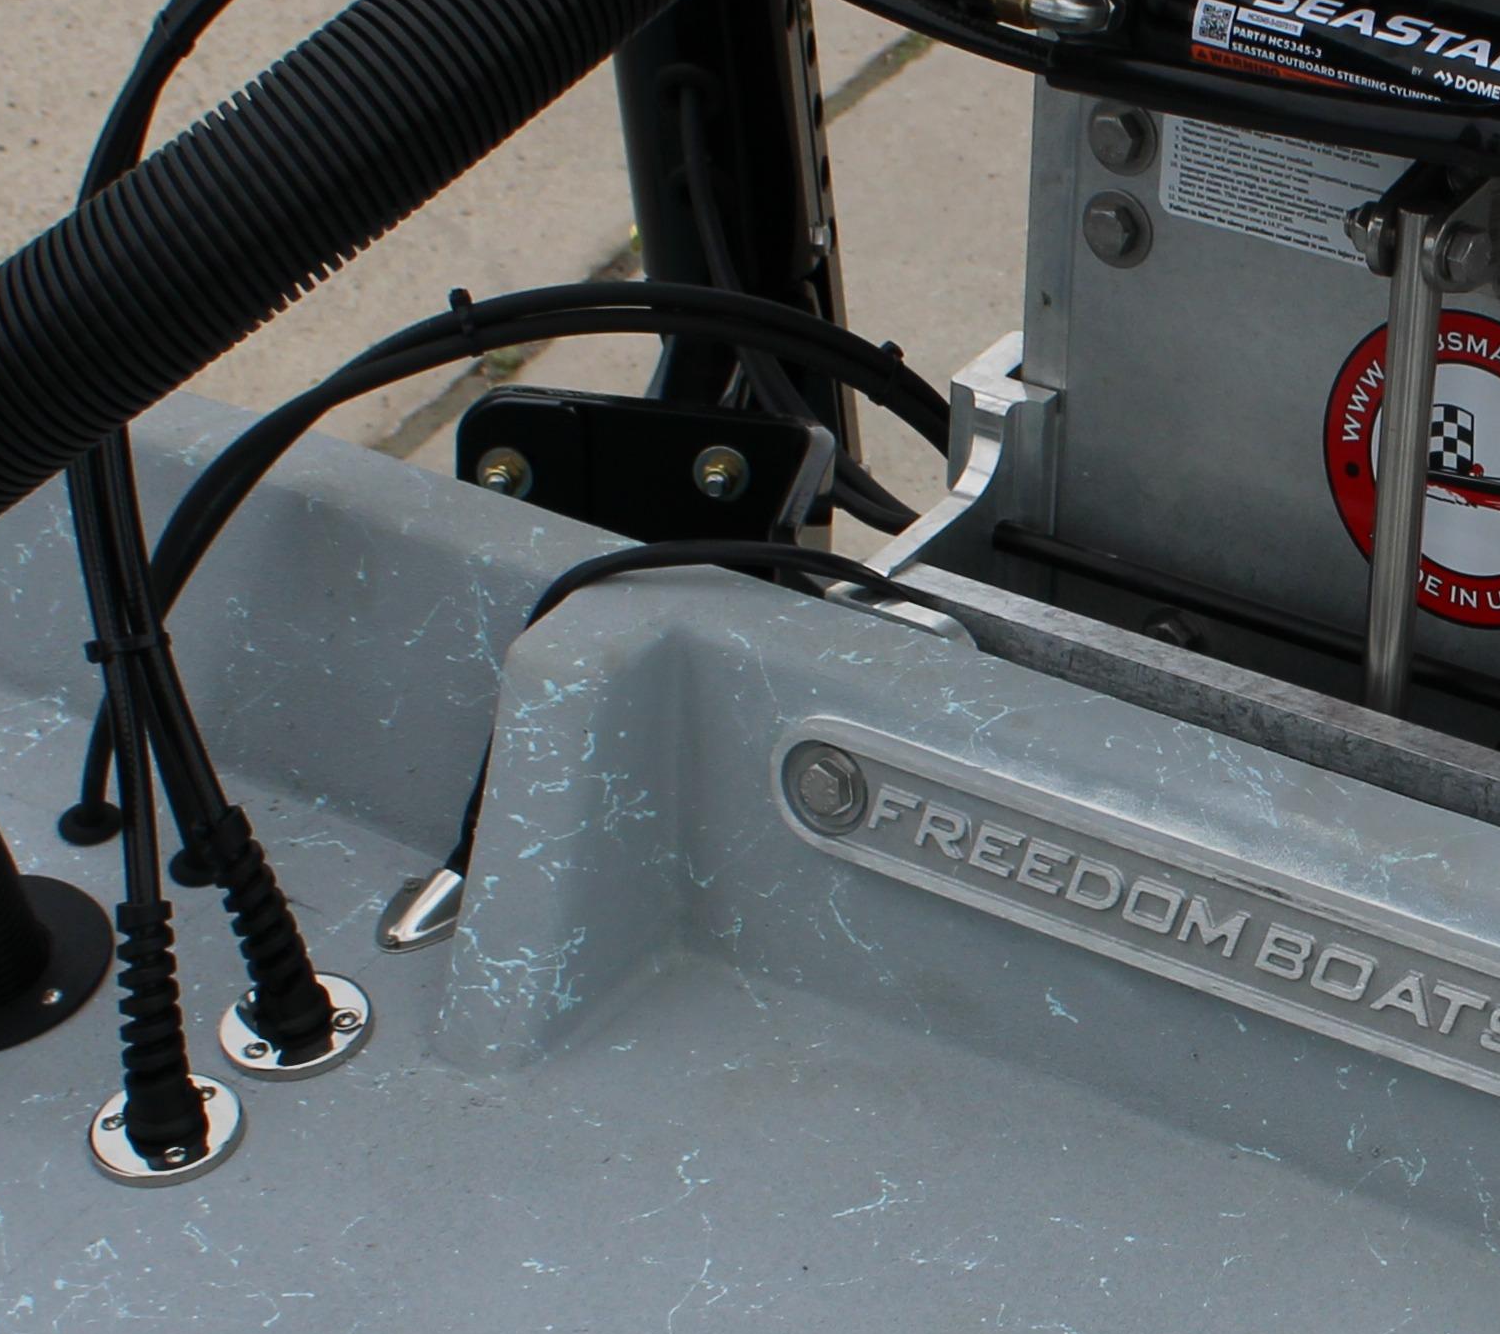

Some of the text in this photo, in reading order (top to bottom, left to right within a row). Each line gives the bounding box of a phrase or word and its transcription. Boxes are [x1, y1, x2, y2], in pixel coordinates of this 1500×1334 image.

[1233, 26, 1323, 59] PART# HC5345-3
[1211, 50, 1281, 78] WARNING
[1231, 42, 1285, 65] SEASTAR
[1285, 54, 1336, 79] OUTBOARD
[1337, 69, 1388, 93] STEERING
[1411, 66, 1423, 77] BY
[1450, 585, 1478, 609] IN
[867, 784, 1250, 959] FREEDOM
